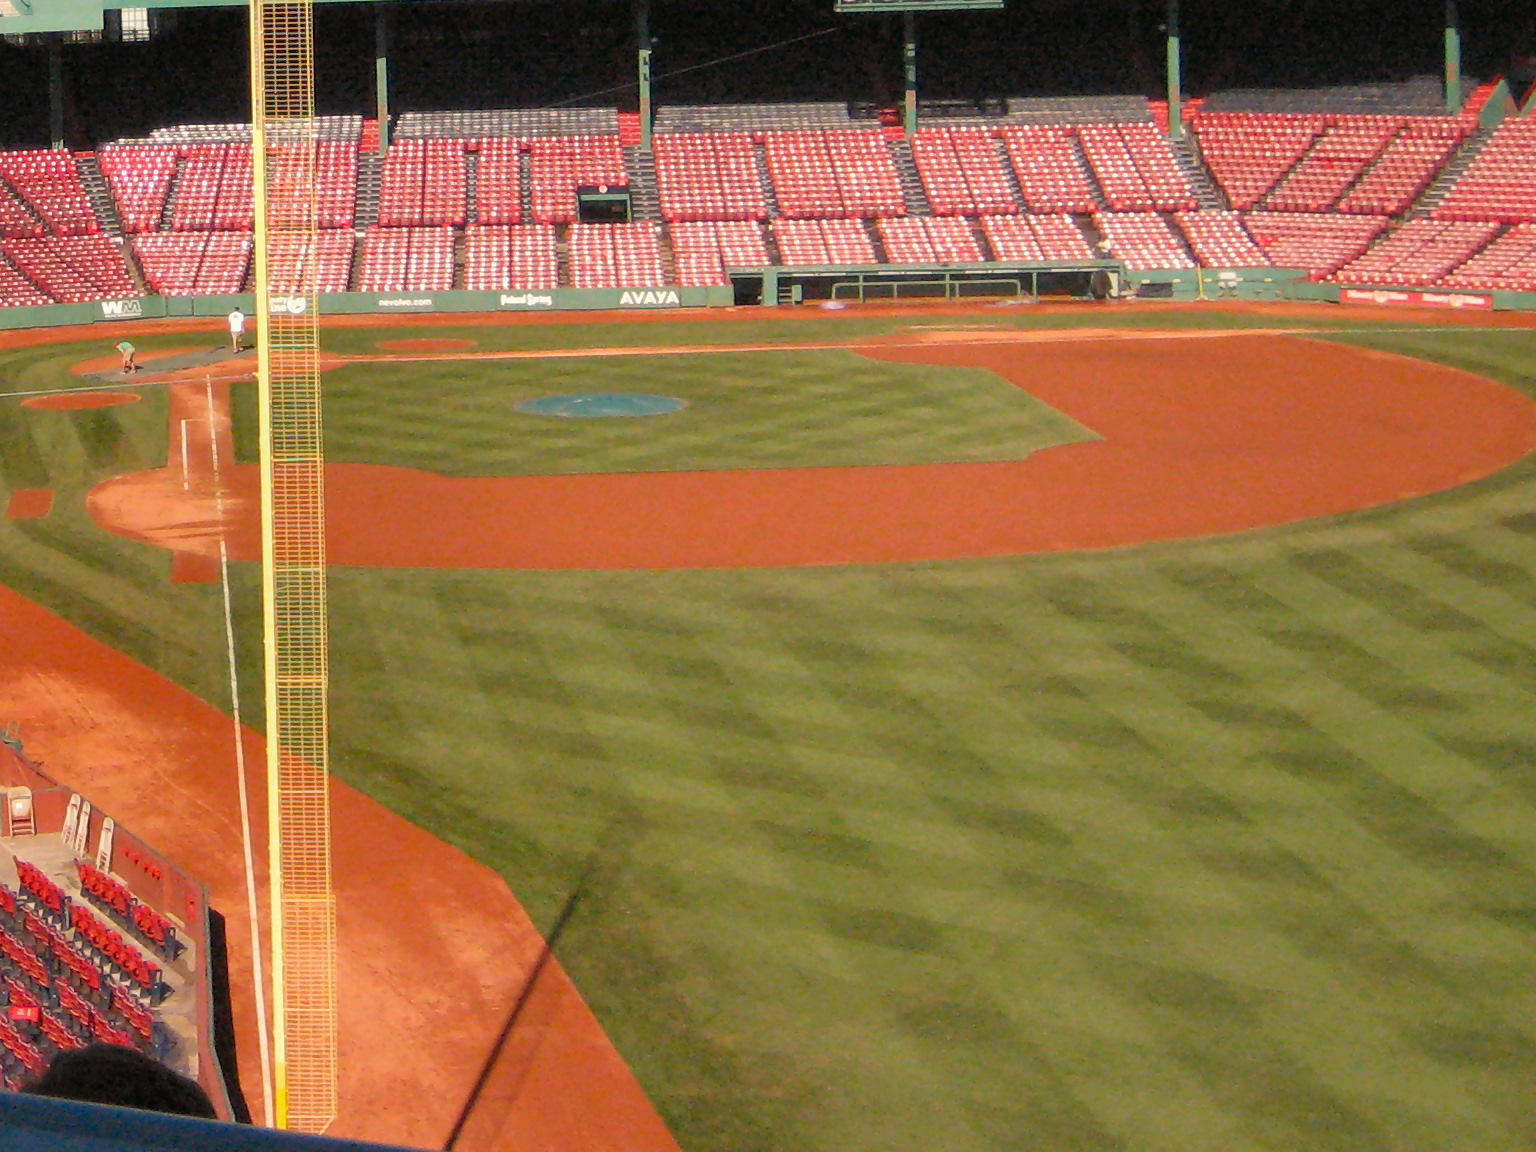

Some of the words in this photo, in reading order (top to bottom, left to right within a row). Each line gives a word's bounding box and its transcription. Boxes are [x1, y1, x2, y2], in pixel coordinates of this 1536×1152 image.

[378, 298, 432, 307] nevolvo.com
[619, 290, 679, 305] AVAYA
[101, 299, 142, 314] WM
